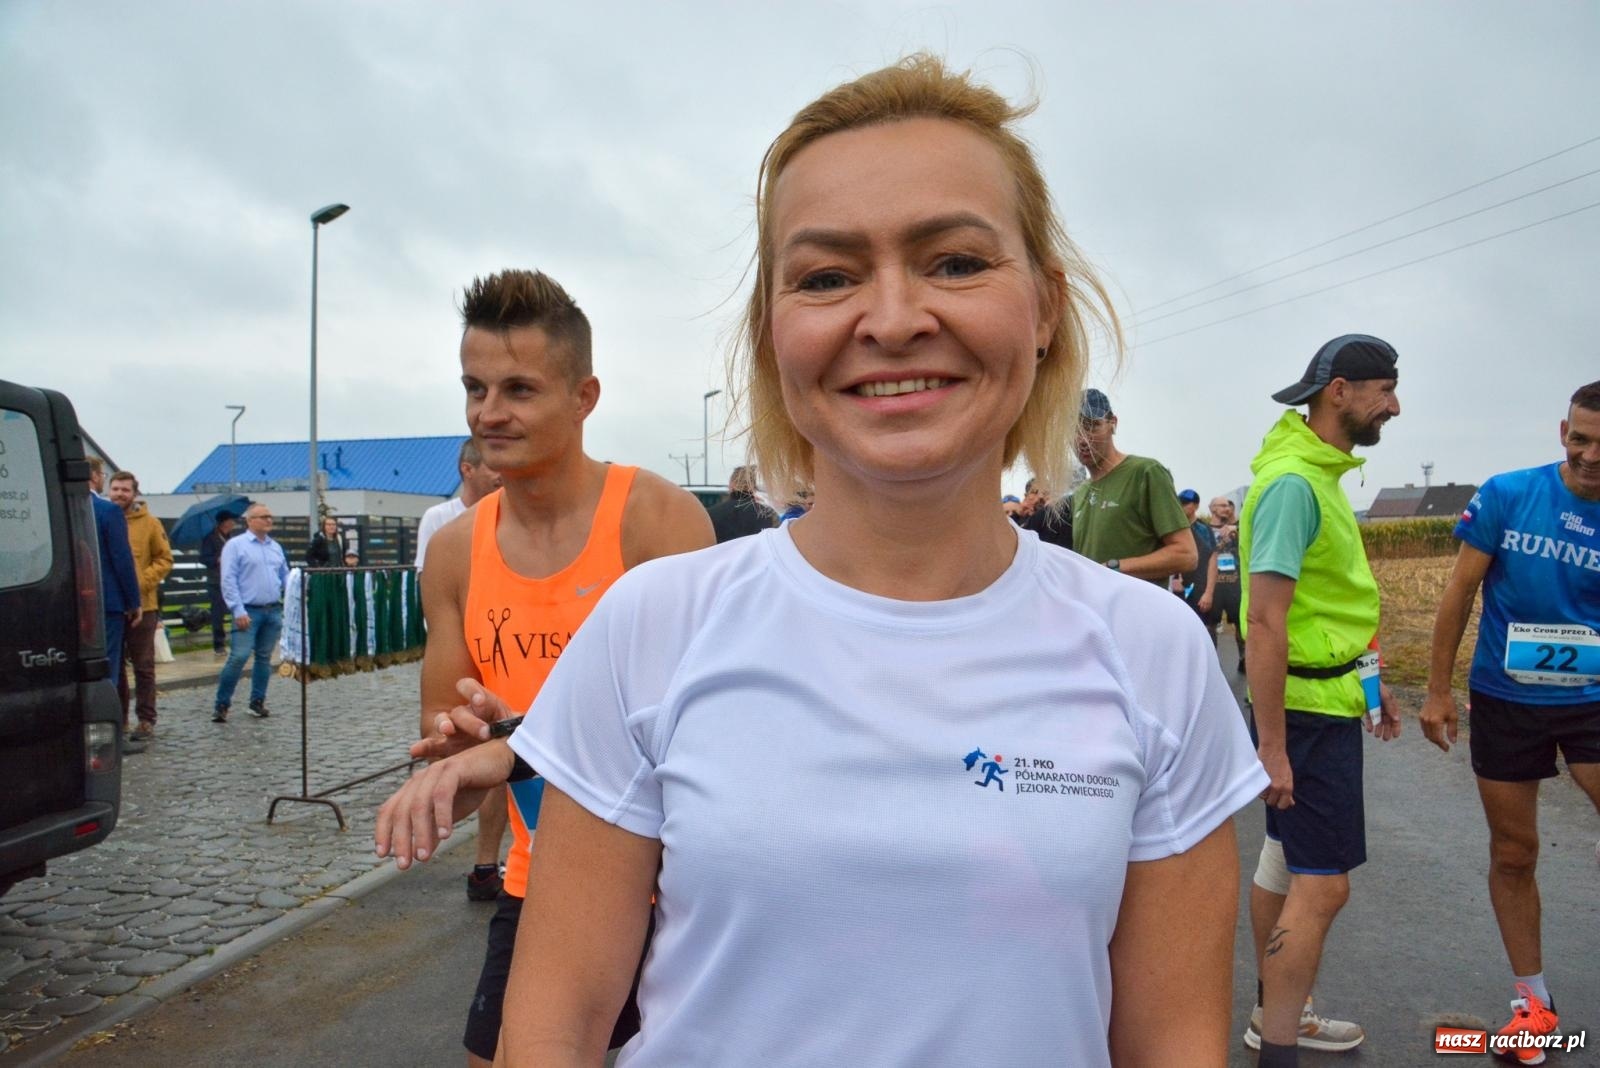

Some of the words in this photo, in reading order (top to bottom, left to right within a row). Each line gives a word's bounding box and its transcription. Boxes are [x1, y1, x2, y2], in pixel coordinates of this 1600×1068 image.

[1535, 645, 1578, 672] 22
[1014, 757, 1030, 767] 21.
[1032, 758, 1054, 769] PKO
[1015, 769, 1084, 783] PÓŁMARATON
[1016, 783, 1059, 795] JEZIORA
[1060, 784, 1114, 798] ŻYWIECKIEGO
